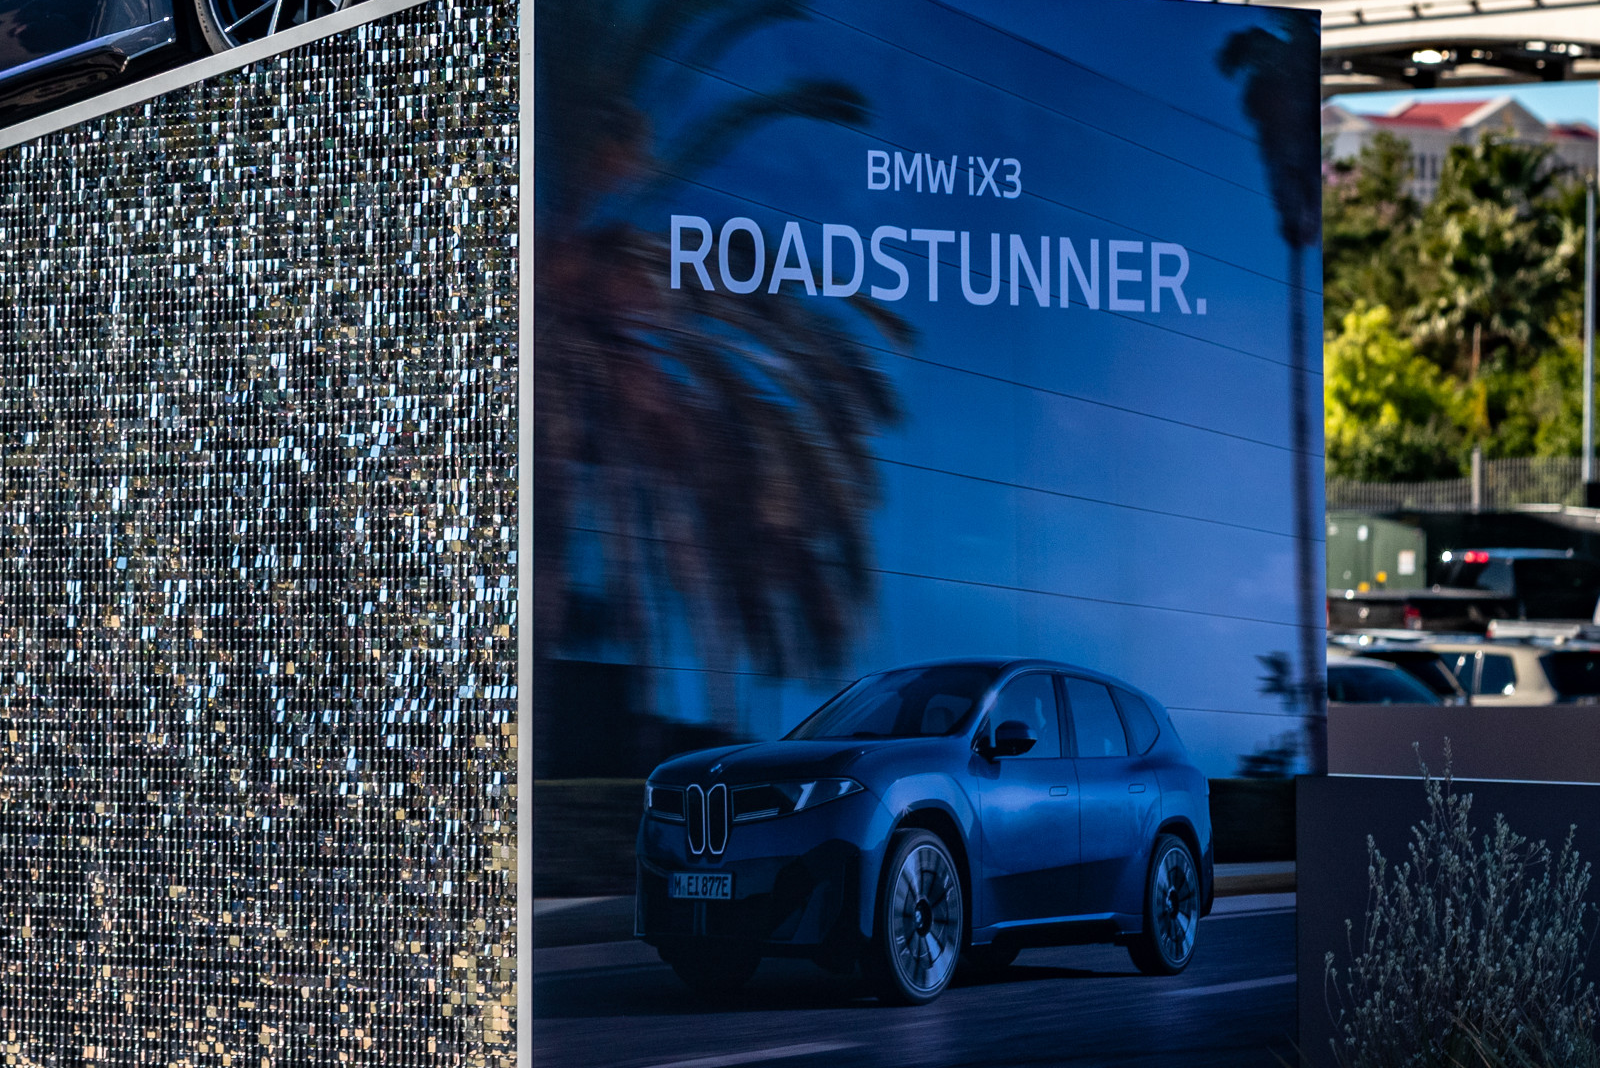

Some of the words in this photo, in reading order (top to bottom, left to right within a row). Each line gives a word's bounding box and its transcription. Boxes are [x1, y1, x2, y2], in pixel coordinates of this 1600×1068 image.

[866, 149, 958, 195] BMW
[967, 156, 1023, 200] iX3
[669, 214, 1208, 316] ROADSTUNNER.
